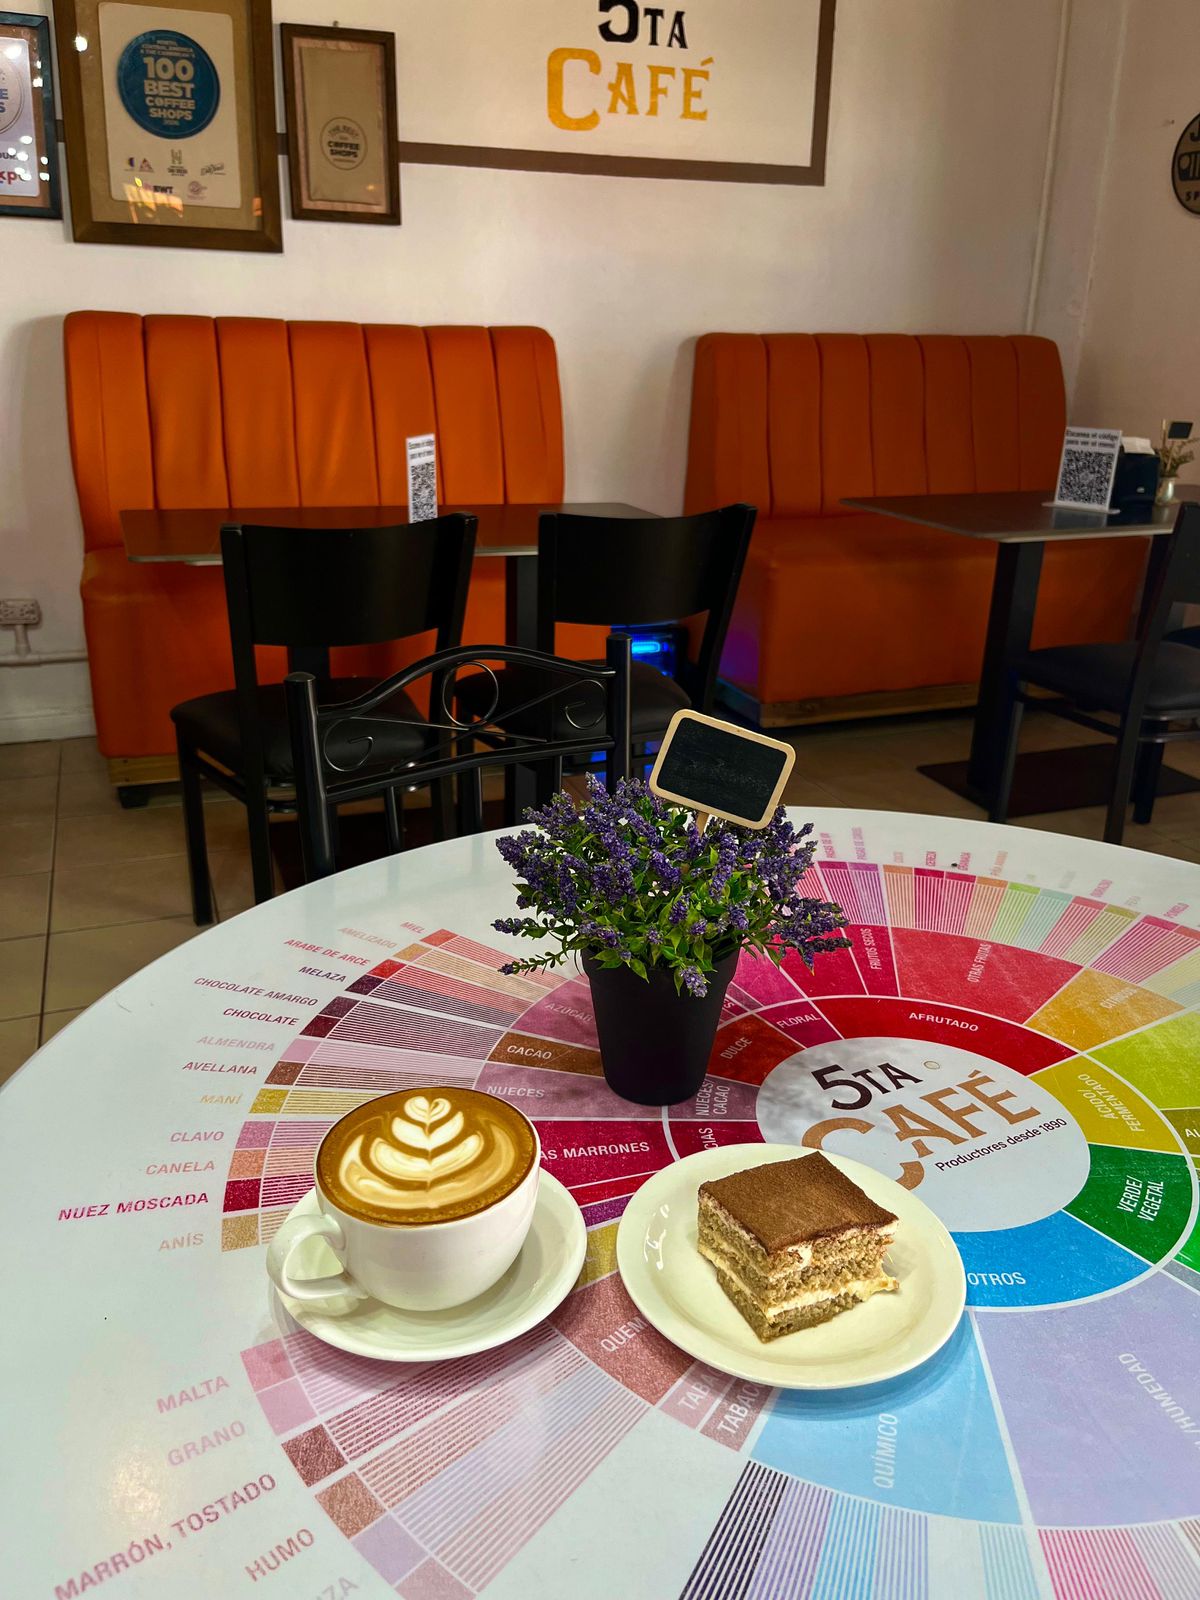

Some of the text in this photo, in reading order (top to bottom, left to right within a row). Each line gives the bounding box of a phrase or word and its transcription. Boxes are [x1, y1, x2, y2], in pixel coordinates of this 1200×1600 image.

[143, 56, 194, 82] 100
[144, 80, 195, 98] BEST
[547, 47, 714, 131] CAFÉ
[145, 96, 196, 110] COFFEE
[149, 108, 193, 120] SHOPS
[283, 939, 371, 967] ARABE DE ARCE
[867, 947, 882, 970] FRUTOS
[298, 966, 347, 983] MELAZA
[967, 963, 983, 983] OTRAS
[194, 977, 318, 1006] CHOCOLATE AMARGO
[223, 1007, 299, 1026] CHOCOLATE
[776, 1013, 821, 1029] FLORAL
[909, 1012, 979, 1032] AFRUTADO
[197, 1035, 275, 1052] ALMENDRA
[507, 1045, 552, 1060] CACAO
[720, 1036, 752, 1060] DULCE
[183, 1060, 258, 1075] AVELLANA
[487, 1086, 545, 1098] NUECES
[811, 1062, 923, 1110] 5TA
[200, 1093, 243, 1105] MANÍ
[713, 1085, 730, 1115] CACAO
[1078, 1073, 1145, 1131] FERMENTADO
[170, 1131, 225, 1143] CLAVO
[698, 1127, 719, 1150] CIAS
[802, 1069, 1041, 1191] CAFÉ
[563, 1141, 650, 1158] MARRONES
[935, 1118, 1067, 1173] Productores desde 1890
[145, 1160, 215, 1175] CANELA
[1117, 1174, 1143, 1212] VERDE/
[1137, 1181, 1164, 1222] VEGETAL
[58, 1192, 209, 1221] NUEZ MOSCADA
[158, 1232, 205, 1252] ANÍS
[967, 1272, 1026, 1286] OTROS
[600, 1316, 649, 1352] QUEM
[156, 1375, 230, 1414] MALTA
[677, 1367, 724, 1410] TABAC
[717, 1384, 766, 1434] TABAC
[167, 1420, 247, 1468] GRANO
[54, 1474, 277, 1600] MARRÓN, TOSTADO
[244, 1528, 314, 1583] HUMO
